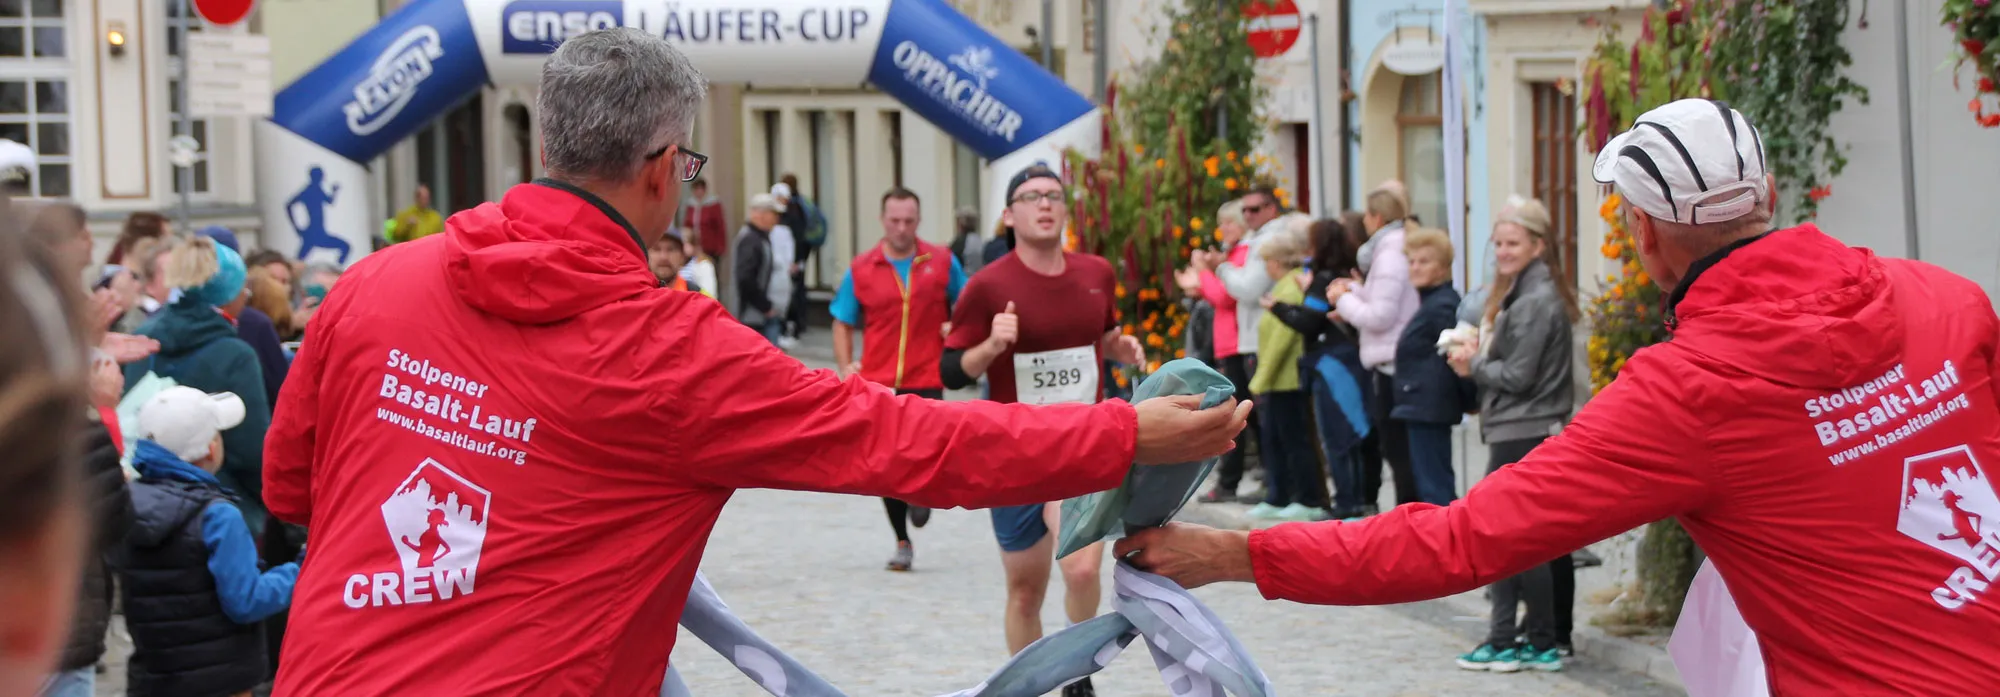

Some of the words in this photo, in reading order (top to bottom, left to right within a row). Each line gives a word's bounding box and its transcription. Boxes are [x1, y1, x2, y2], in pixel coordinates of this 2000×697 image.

[893, 40, 1022, 141] OPPACHER
[387, 349, 488, 398] Stolpener
[1033, 368, 1081, 389] 5289
[1804, 363, 1905, 418] Stolpener
[379, 374, 537, 442] Basalt-Lauf
[1814, 360, 1959, 446] Basalt-Lauf
[1828, 393, 1969, 466] www.basaltlauf.org
[376, 407, 527, 465] www.basaltlauf.org
[343, 566, 477, 608] CREW
